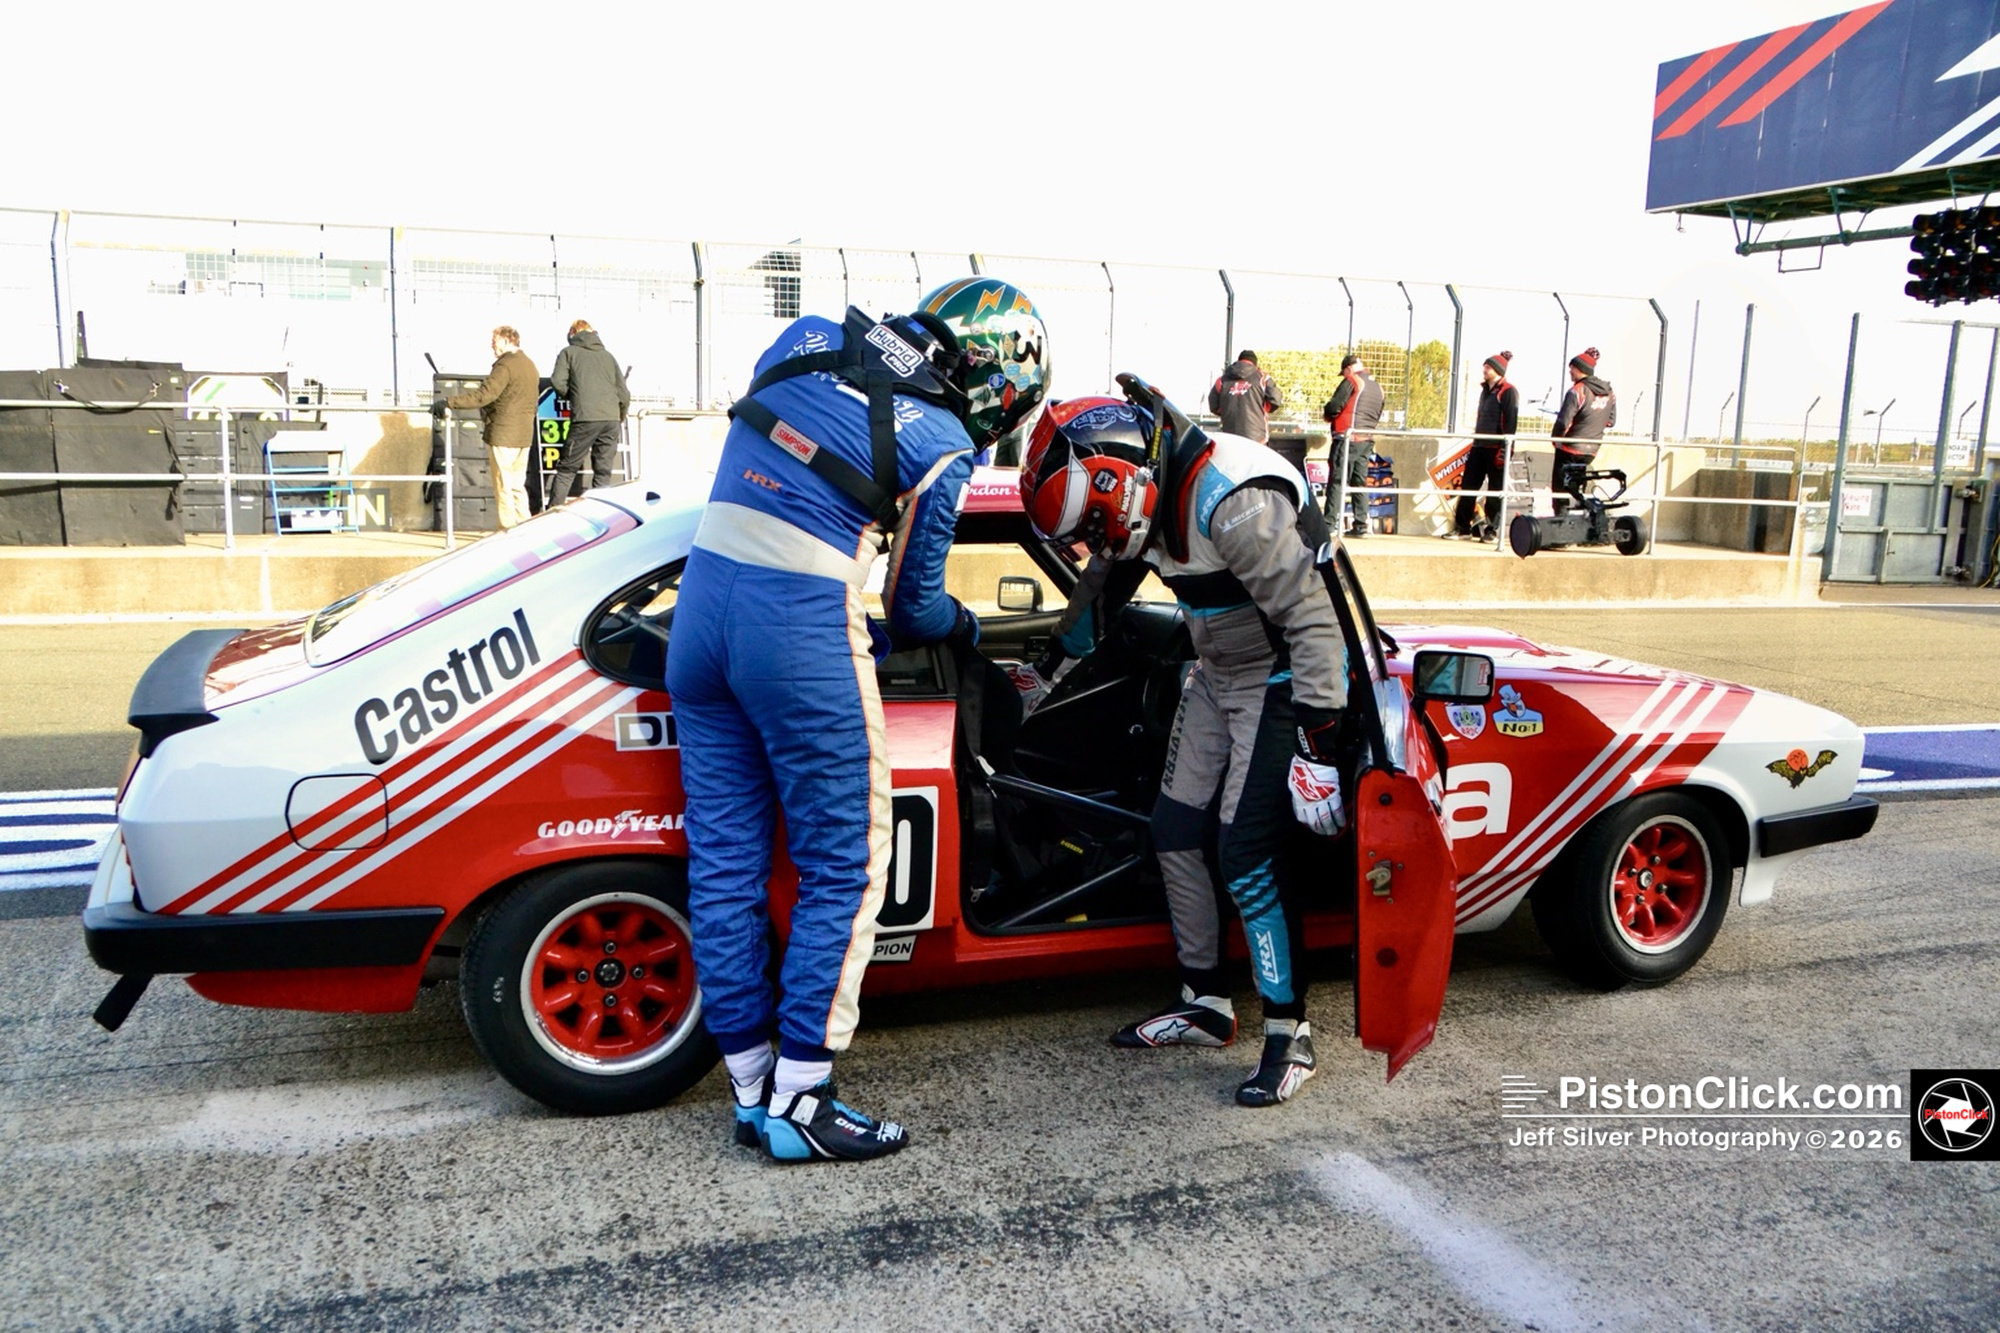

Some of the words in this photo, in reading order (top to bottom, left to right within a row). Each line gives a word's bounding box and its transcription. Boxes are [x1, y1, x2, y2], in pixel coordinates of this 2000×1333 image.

[874, 329, 918, 366] Hybrid
[888, 355, 909, 374] PRO
[776, 426, 813, 456] SIMPSON
[1434, 452, 1470, 481] WHITAK
[743, 469, 782, 491] HRX
[968, 484, 1012, 496] rdon
[354, 606, 541, 766] Castrol
[873, 942, 912, 956] PION
